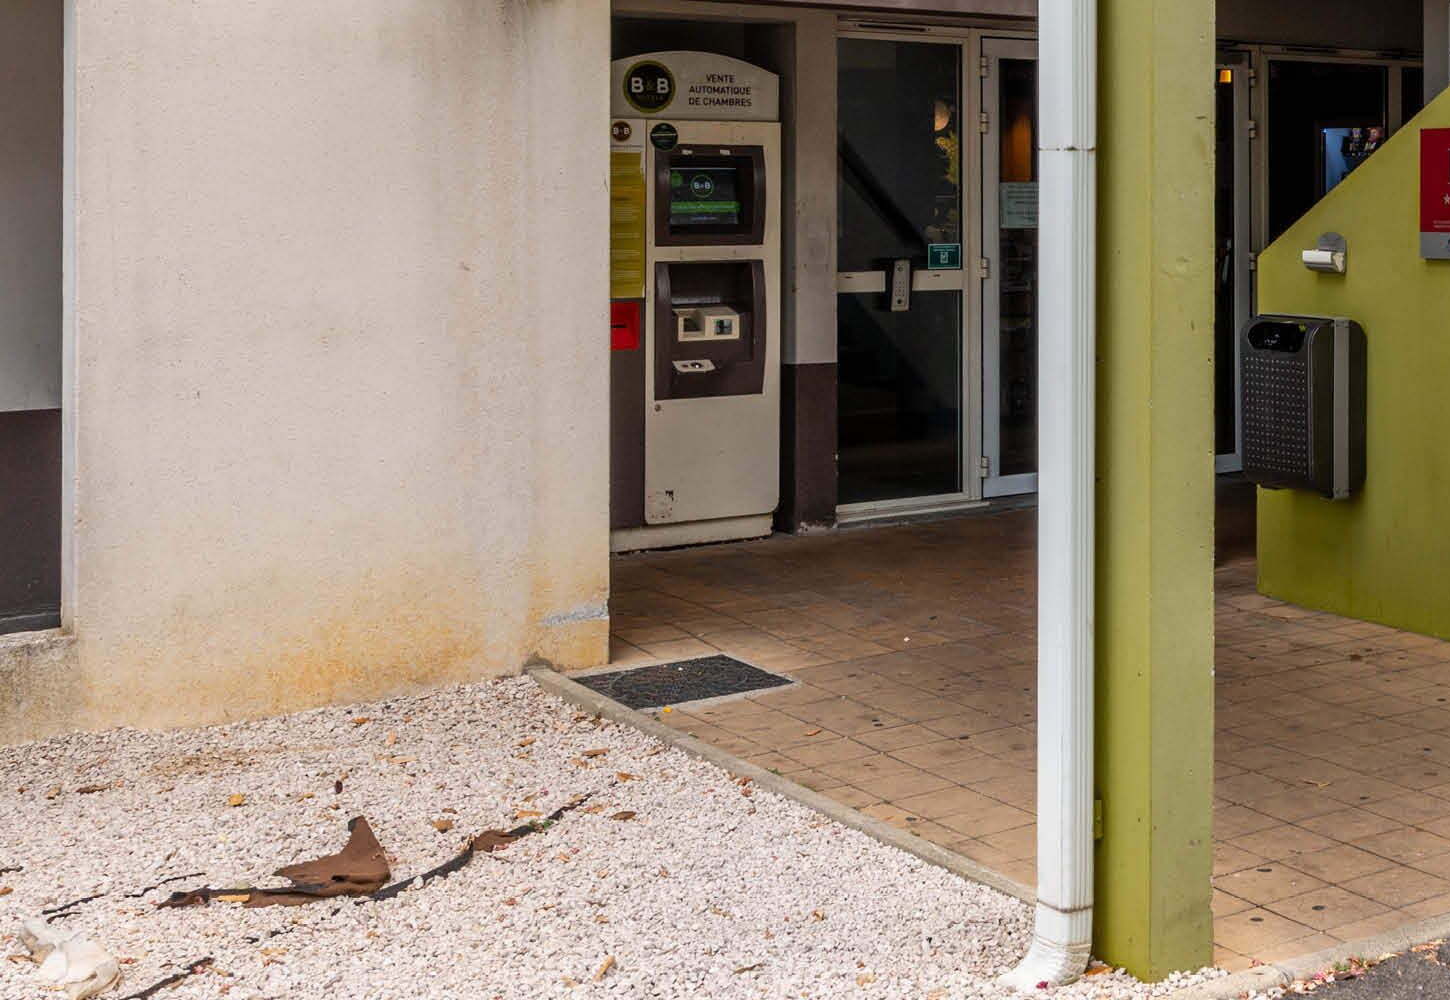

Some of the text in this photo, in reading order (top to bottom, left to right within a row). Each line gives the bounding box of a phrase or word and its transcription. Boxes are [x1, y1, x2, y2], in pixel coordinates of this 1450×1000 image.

[706, 74, 735, 83] VENTE
[689, 86, 751, 95] AUTOMATIQUE
[689, 98, 752, 106] DE CHAMBRES
